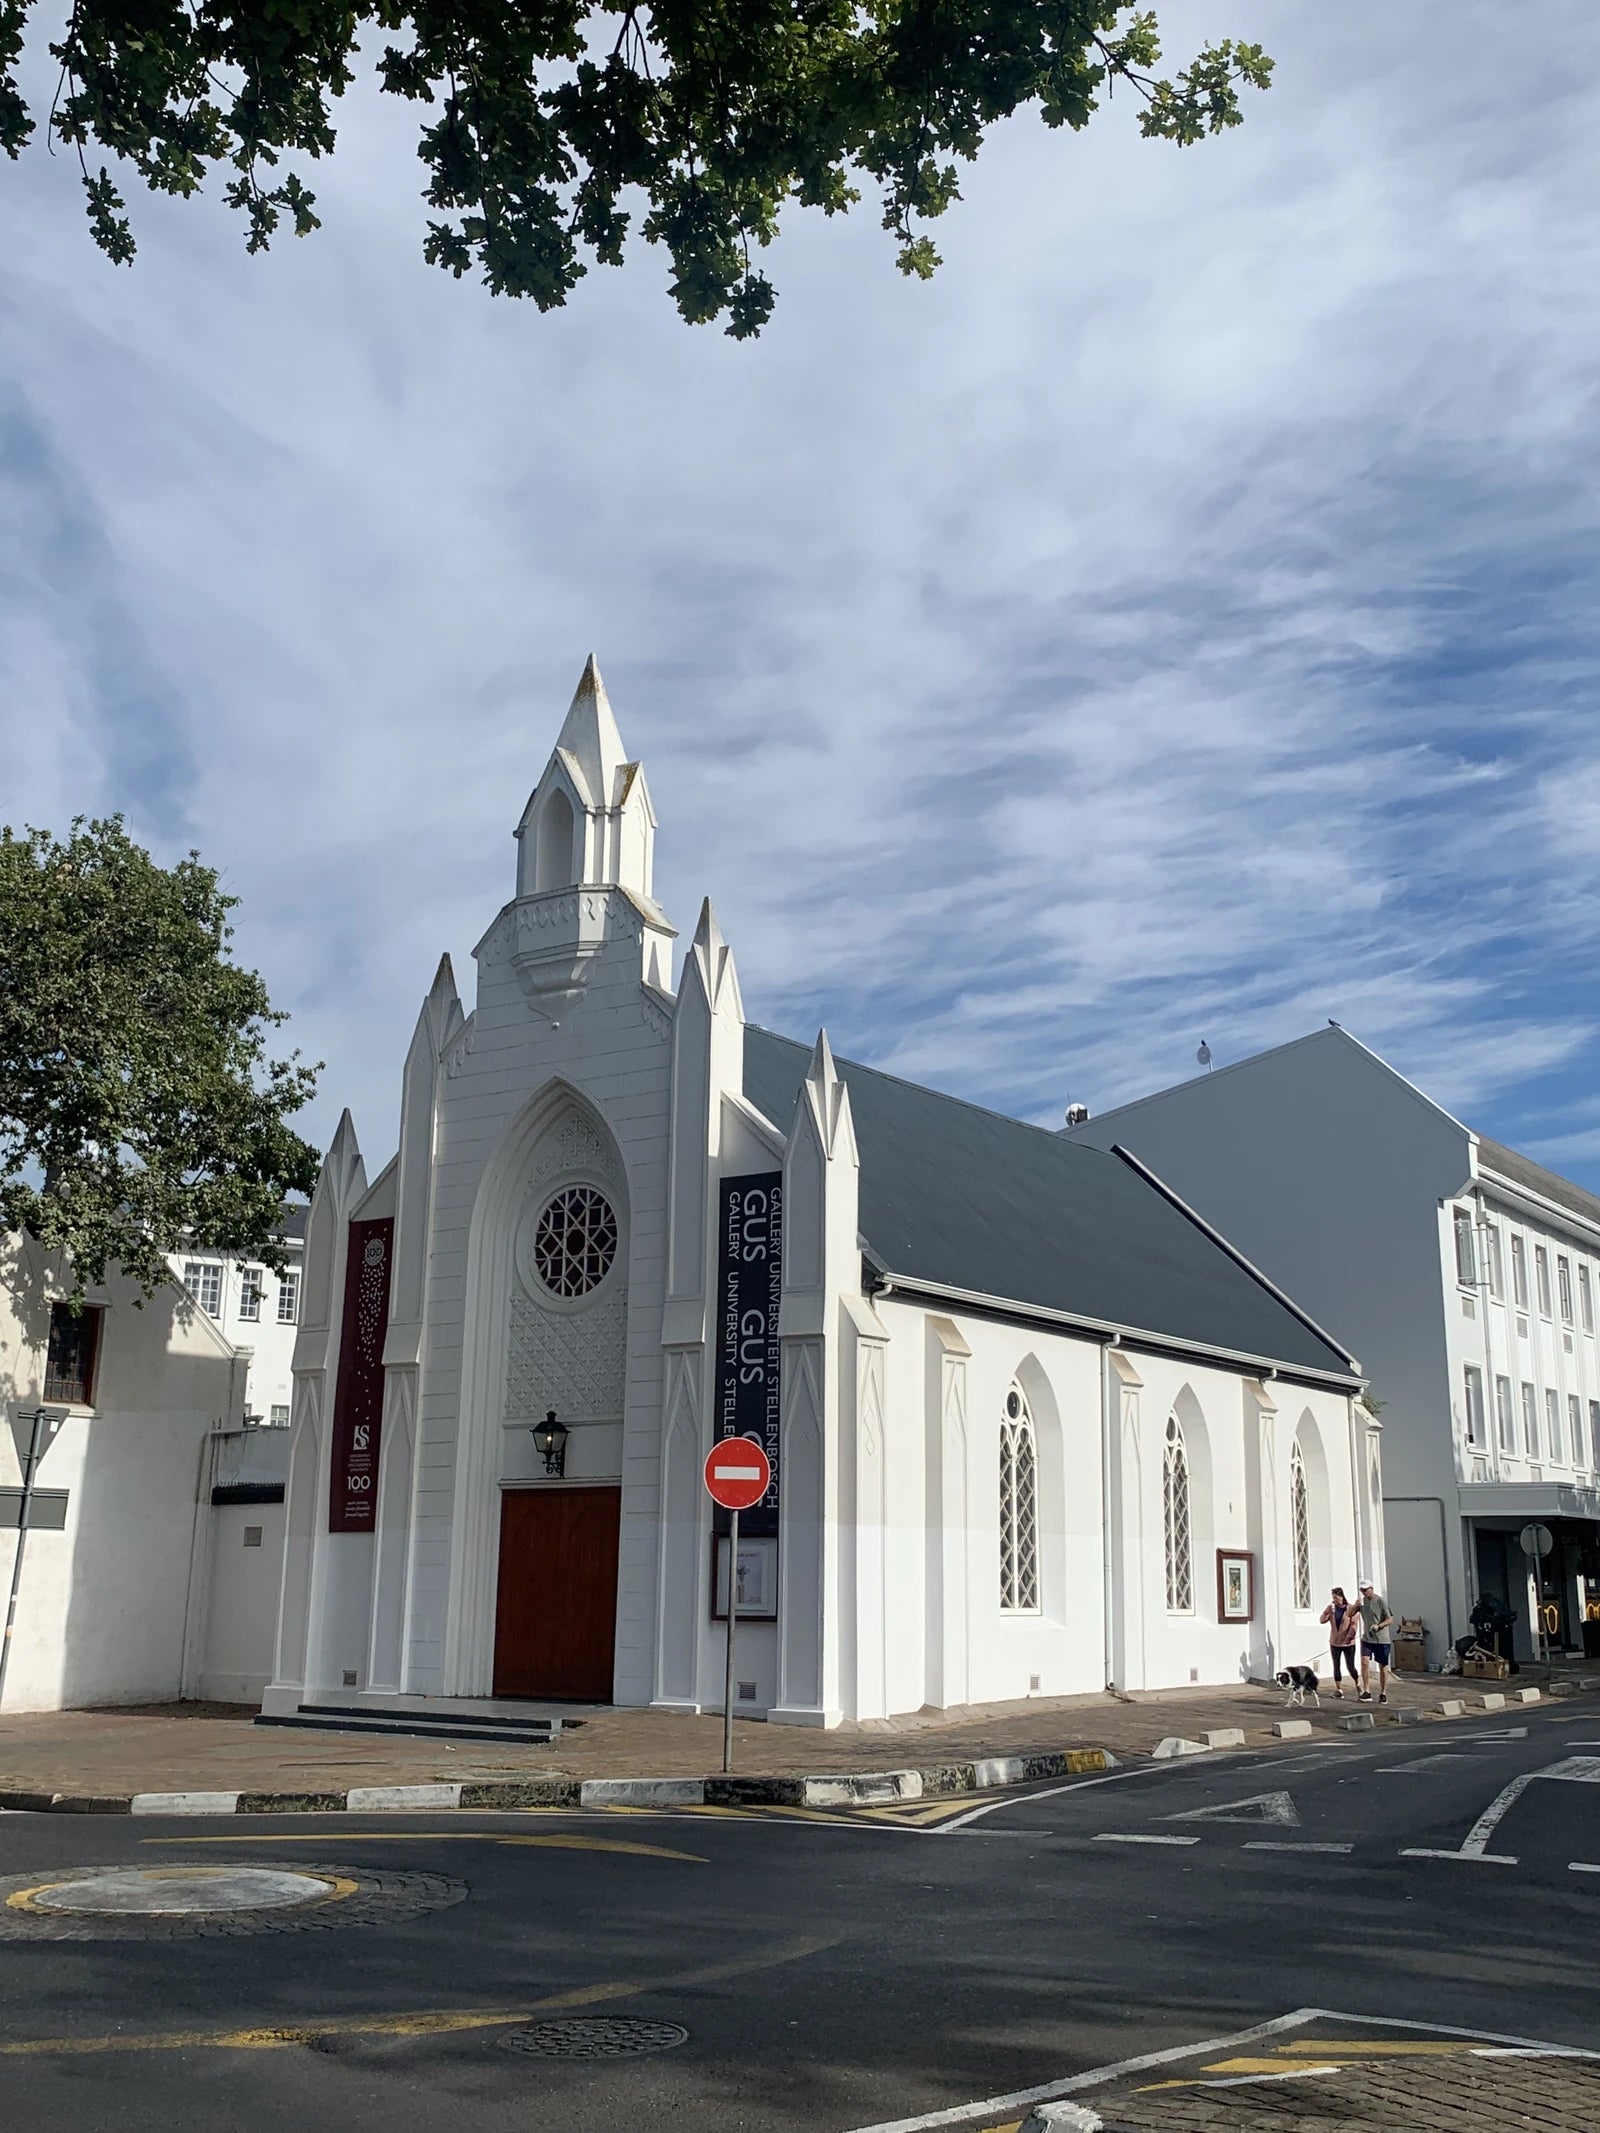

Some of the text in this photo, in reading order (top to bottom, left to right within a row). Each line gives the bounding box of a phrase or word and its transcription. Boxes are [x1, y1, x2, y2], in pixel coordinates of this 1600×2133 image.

[723, 1191, 741, 1438] GALLERY UNIVERSITY STELLE
[740, 1189, 767, 1385] GUS GUS
[766, 1187, 782, 1509] GALLERY UNIVERSITEIT STELLENBOSCH
[347, 1475, 371, 1490] 100
